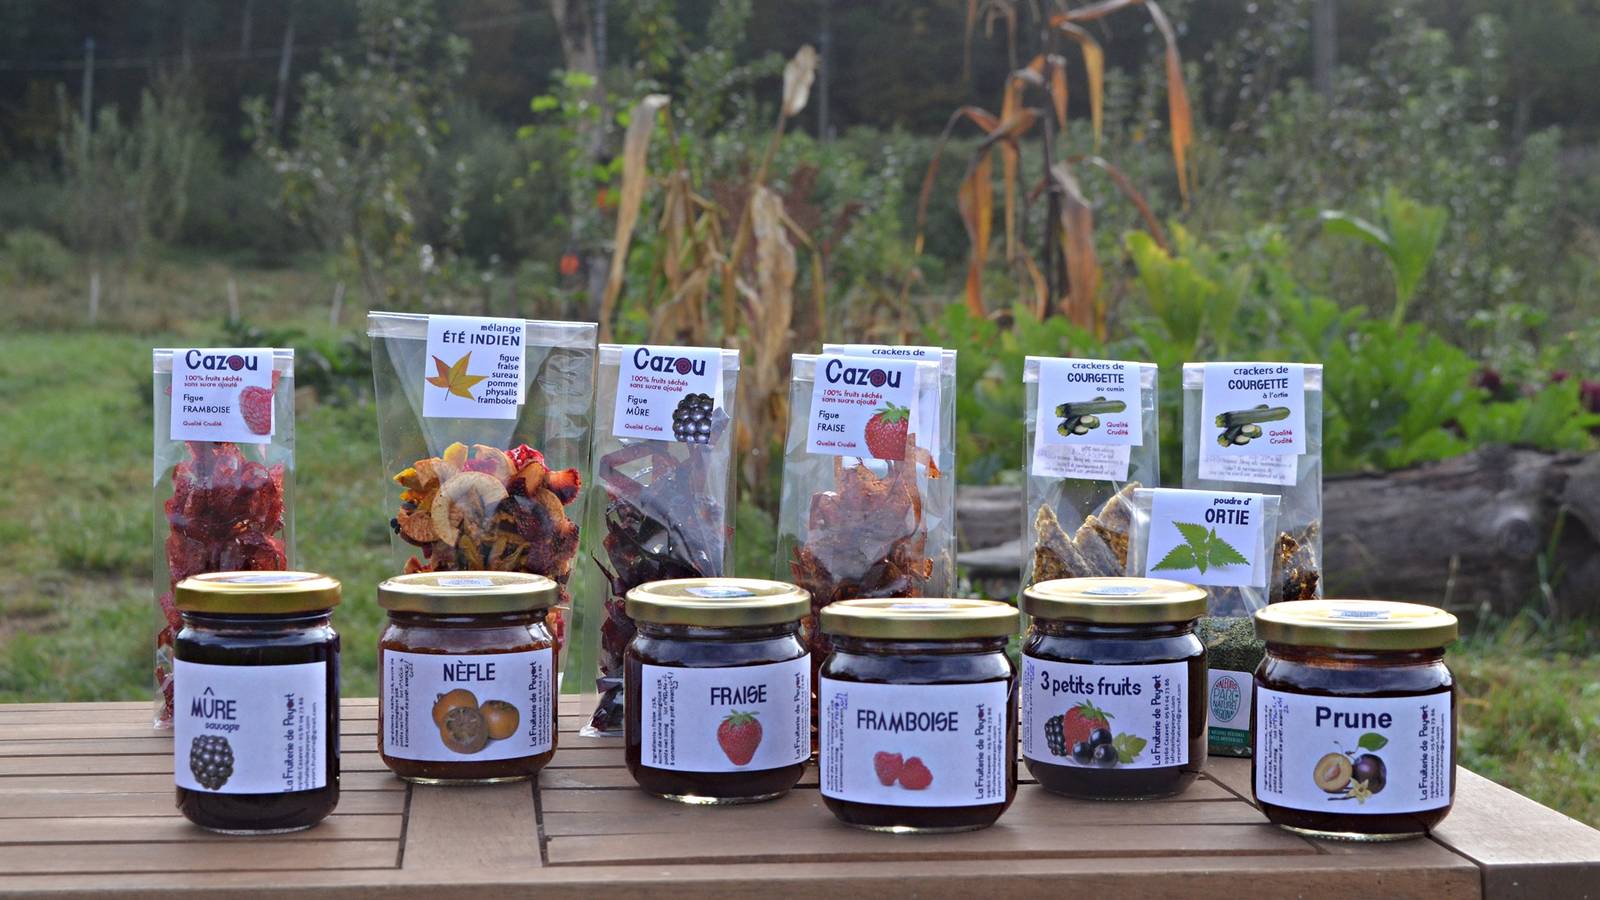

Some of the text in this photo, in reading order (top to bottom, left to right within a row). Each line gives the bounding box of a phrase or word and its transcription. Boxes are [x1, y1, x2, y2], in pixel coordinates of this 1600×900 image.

[481, 324, 521, 334] mélange
[443, 330, 520, 346] ÉTÉ INDIEN
[872, 348, 910, 356] crackers
[185, 349, 258, 371] Cazou
[500, 354, 519, 363] figue
[633, 348, 706, 376] Cazou
[498, 362, 519, 370] fraise
[1072, 362, 1110, 370] crackers
[1234, 366, 1288, 375] crackers de
[826, 359, 901, 388] Cazou
[1067, 372, 1124, 384] COURGETTE
[487, 380, 518, 388] pomme
[651, 376, 666, 384] fruits
[668, 378, 688, 387] séchés
[1228, 378, 1288, 390] COURGETTE
[486, 388, 518, 396] physalis
[663, 385, 683, 393] ajouté
[844, 390, 859, 398] fruits
[861, 391, 882, 399] séchés
[184, 394, 204, 403] Figue
[477, 396, 517, 405] framboise
[628, 395, 647, 405] Figue
[856, 398, 877, 406] ajouté
[183, 406, 230, 414] FRAMBOISE
[626, 406, 650, 416] MÛRE
[819, 410, 839, 420] Figue
[817, 423, 845, 433] FRAISE
[1214, 497, 1242, 506] poudre
[1205, 508, 1249, 525] ORTIE
[444, 660, 495, 682] NÈFLE
[528, 661, 538, 690] Peyort
[1041, 671, 1141, 696] 3 petits fruits
[710, 684, 767, 705] FRAISE
[1151, 675, 1163, 705] Peyort
[191, 686, 237, 720] MÛRE
[530, 693, 537, 702] de
[283, 693, 297, 726] Peyort
[1152, 708, 1161, 719] de
[857, 709, 958, 733] FRAMBOISE
[975, 704, 985, 735] Peyort
[1316, 706, 1393, 729] Prune
[1419, 705, 1430, 737] Peyort
[205, 722, 240, 733] sauvage
[284, 730, 294, 740] de
[1151, 721, 1161, 754] Fruiterie
[976, 739, 984, 750] de
[1420, 741, 1428, 751] de
